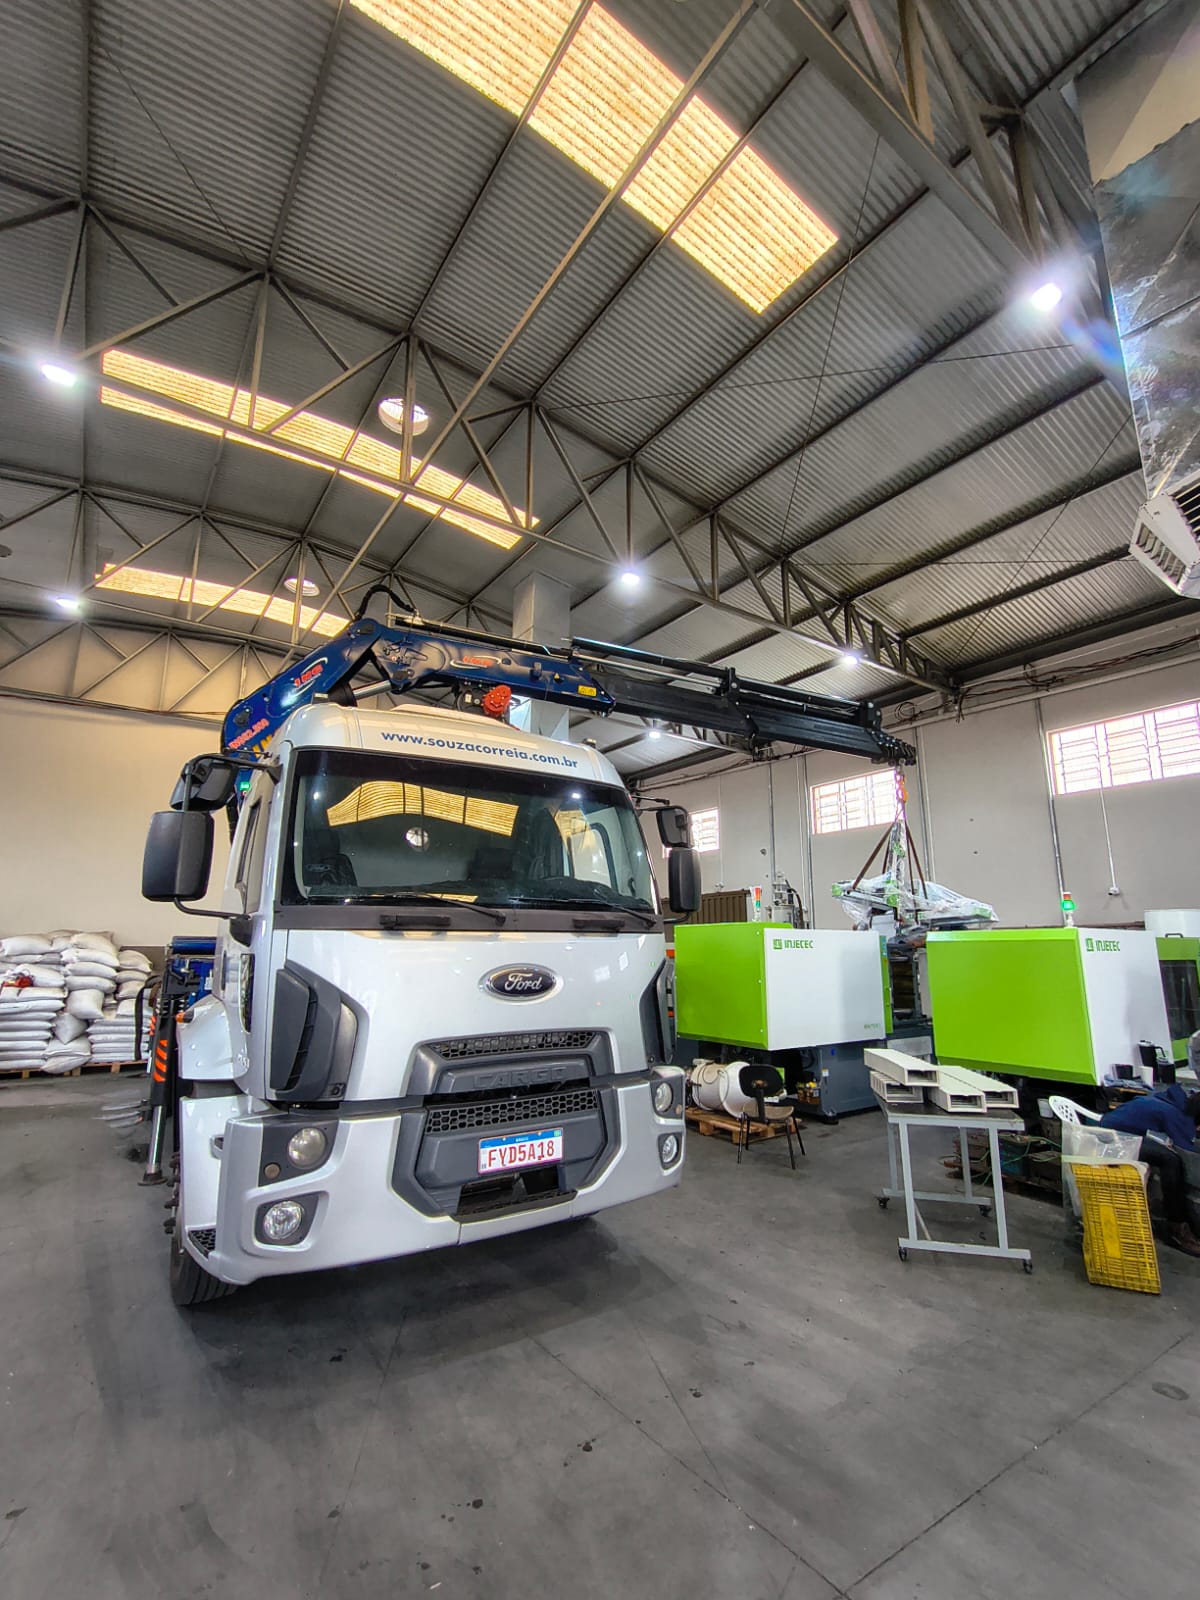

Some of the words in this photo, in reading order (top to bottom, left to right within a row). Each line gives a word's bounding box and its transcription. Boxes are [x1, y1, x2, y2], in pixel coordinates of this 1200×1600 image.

[381, 731, 577, 768] www.souzacorreia.com.br
[505, 973, 543, 991] Ford
[488, 1140, 554, 1167] FYD5A18
